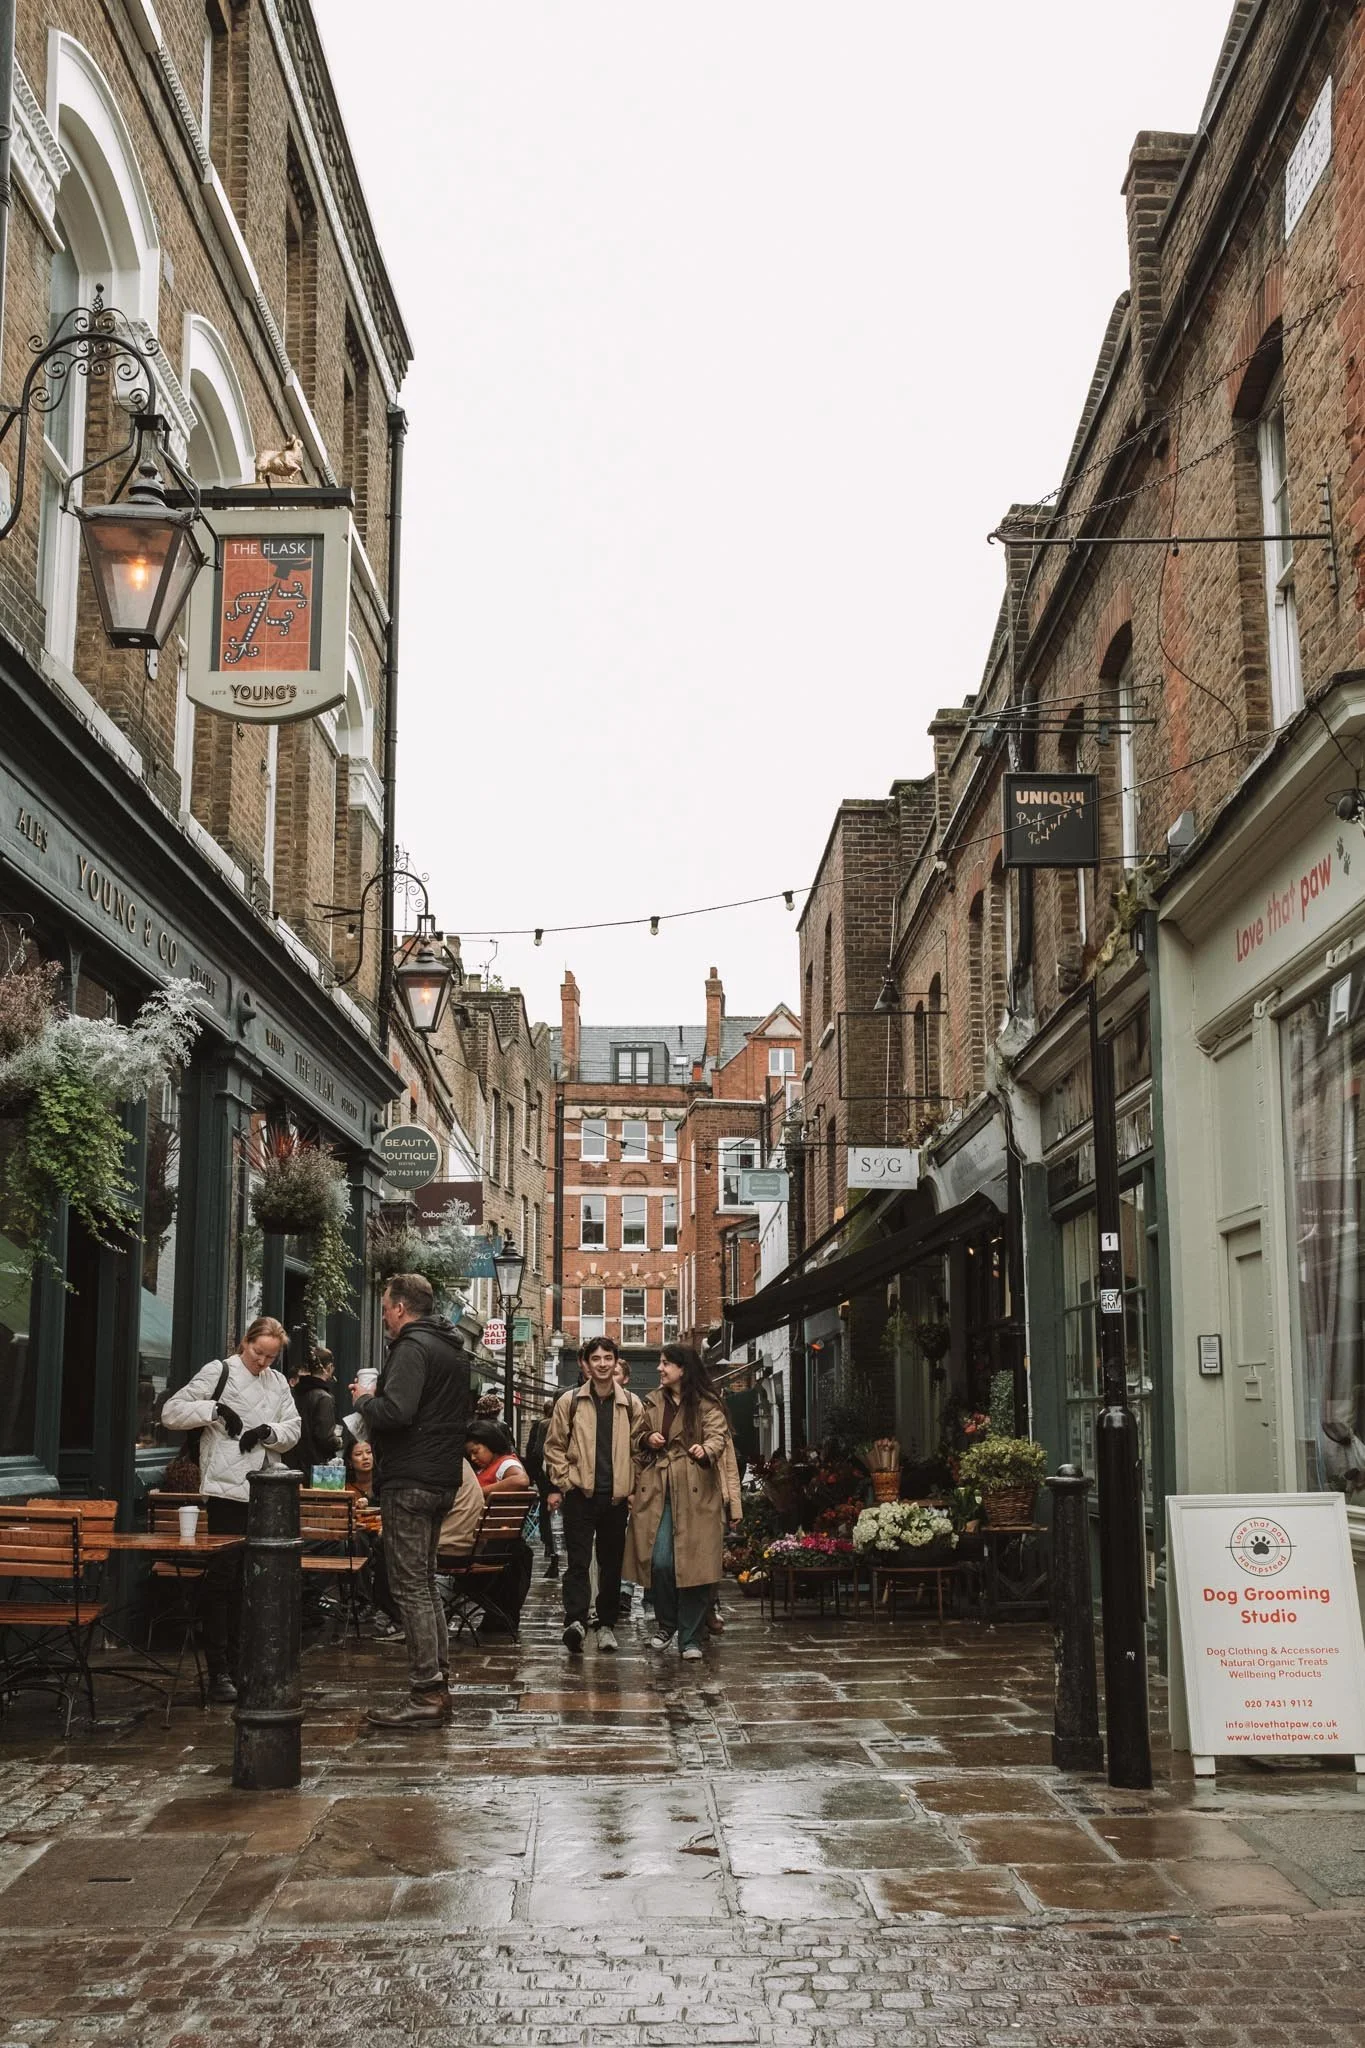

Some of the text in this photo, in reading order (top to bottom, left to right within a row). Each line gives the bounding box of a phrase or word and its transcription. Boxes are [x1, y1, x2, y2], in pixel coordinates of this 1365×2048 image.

[232, 542, 306, 555] THE FLASK
[230, 684, 297, 701] YOUNG'S
[77, 854, 137, 934] YOUNG
[144, 917, 153, 948] &
[159, 931, 178, 969] CO
[1235, 853, 1331, 963] Love that paw
[385, 1139, 431, 1147] BEAUTY
[380, 1152, 437, 1160] BOUTIQUE
[1105, 1235, 1112, 1246] 1
[1234, 1527, 1248, 1545] Love
[1271, 1527, 1286, 1545] paw
[1238, 1555, 1287, 1574] Hampstead
[1203, 1586, 1330, 1605] Dog Grooming
[1241, 1609, 1297, 1624] Studio
[1206, 1646, 1339, 1657] Dog Clothing & Accessories
[1220, 1657, 1328, 1668] Natural Organic Treats
[1229, 1669, 1322, 1680] Wellbeing Products
[1244, 1699, 1313, 1708] 020 7431 9112
[1225, 1719, 1338, 1730] info@lovethatpaw.co.uk
[1227, 1732, 1339, 1742] www.lovethatpaw.co.uk
